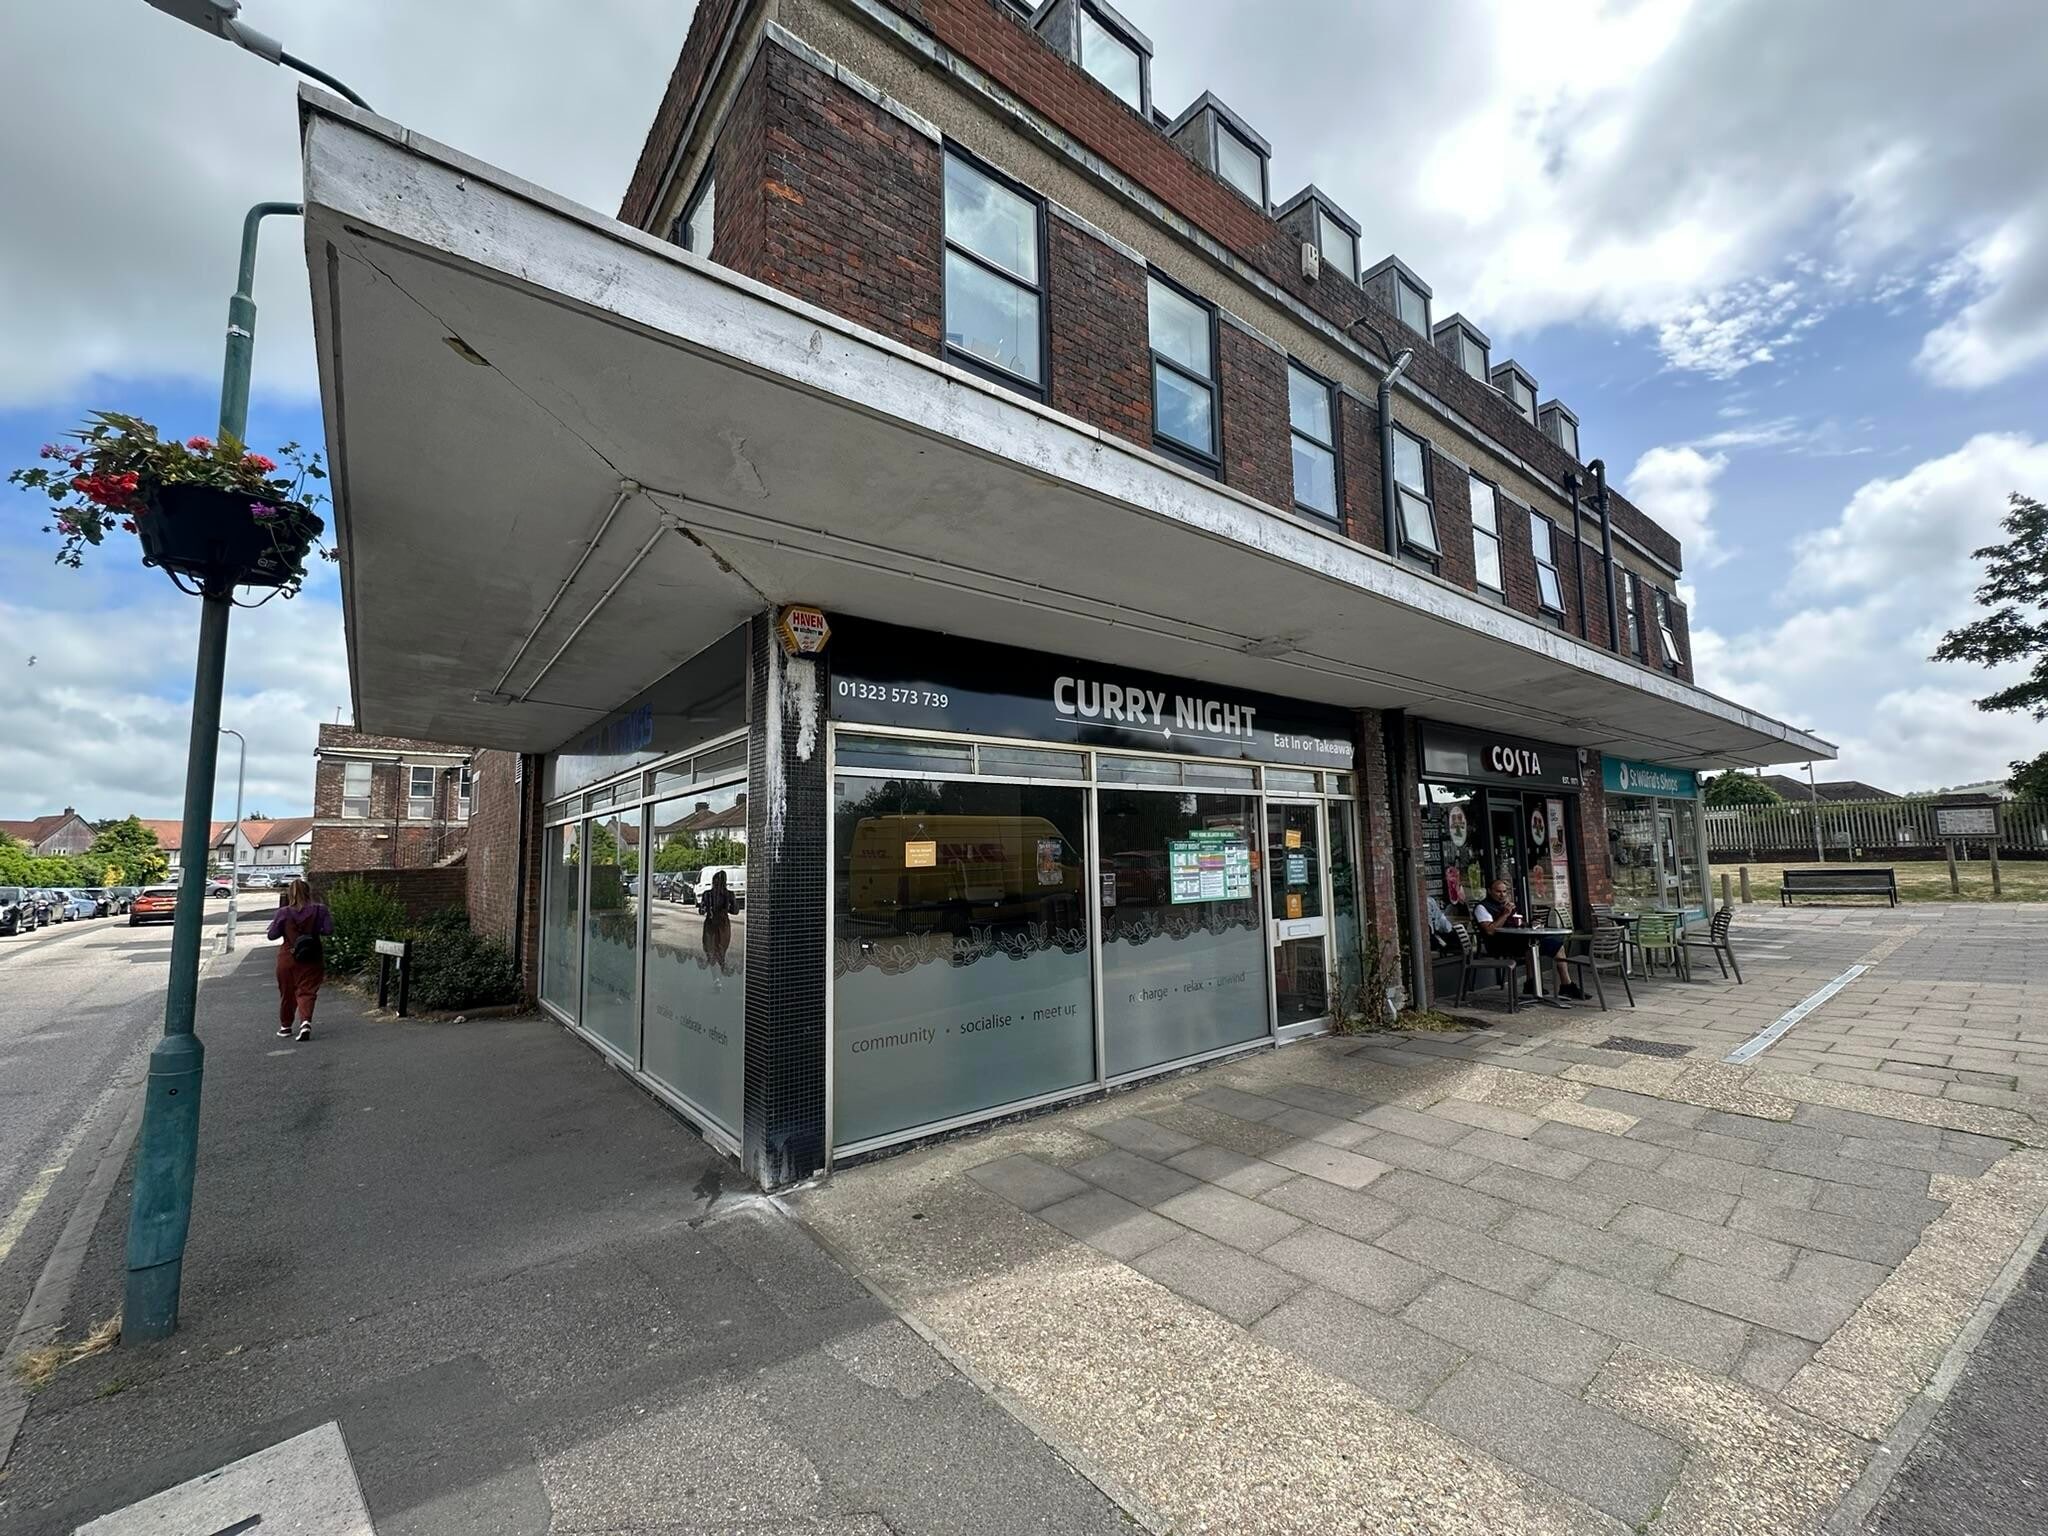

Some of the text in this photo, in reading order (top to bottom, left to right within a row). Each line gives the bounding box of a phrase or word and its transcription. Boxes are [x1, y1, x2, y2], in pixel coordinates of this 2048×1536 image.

[793, 612, 823, 629] HAVEN
[838, 682, 948, 708] 01323 573 739
[1054, 676, 1256, 737] CURRY NIGHT
[1274, 733, 1355, 759] Eat In or Takeaway
[1492, 746, 1541, 776] COSTA
[1660, 773, 1678, 794] Shops
[1183, 980, 1204, 993] relax
[851, 1026, 936, 1053] community
[960, 1013, 1012, 1034] socialise
[1033, 1005, 1061, 1021] meet
